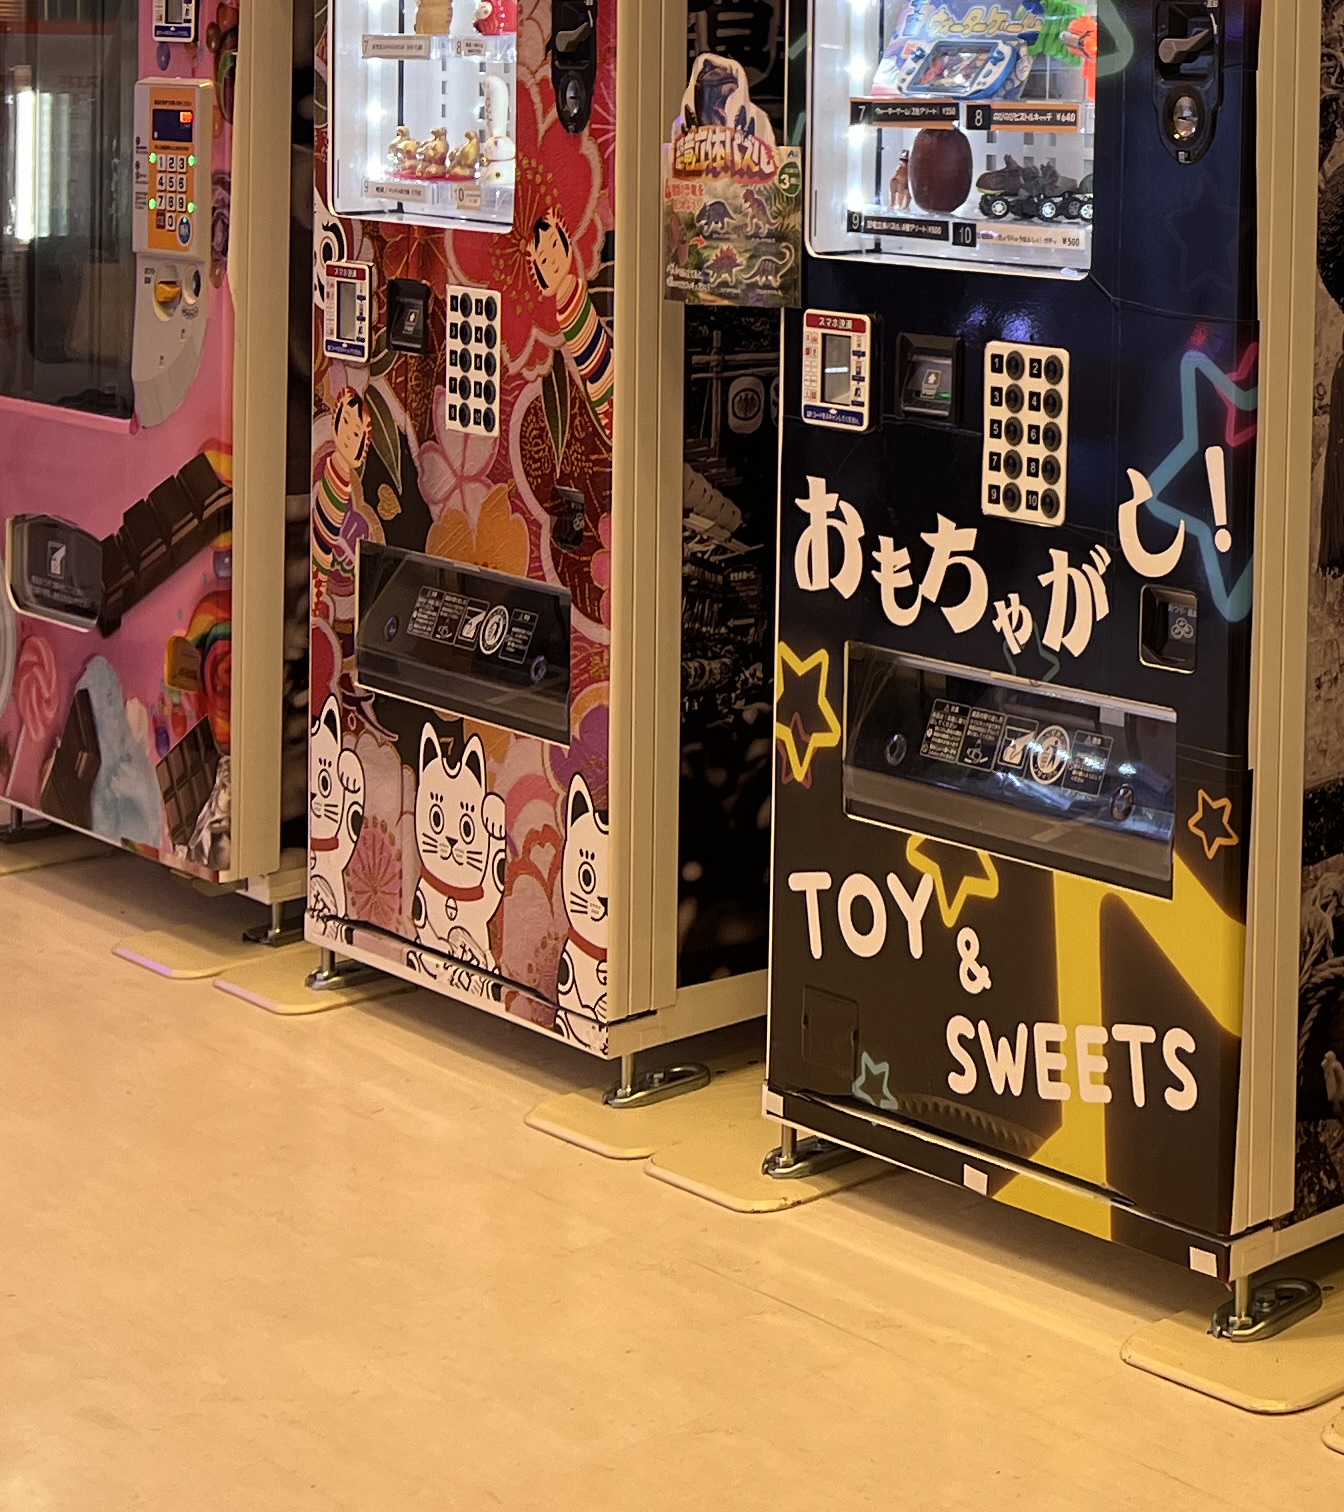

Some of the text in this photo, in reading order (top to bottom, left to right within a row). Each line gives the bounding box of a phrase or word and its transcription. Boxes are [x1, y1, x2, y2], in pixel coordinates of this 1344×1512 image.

[959, 227, 972, 245] 10
[788, 871, 934, 960] TOY
[957, 926, 992, 994] &
[946, 1014, 1199, 1111] SWEETS
